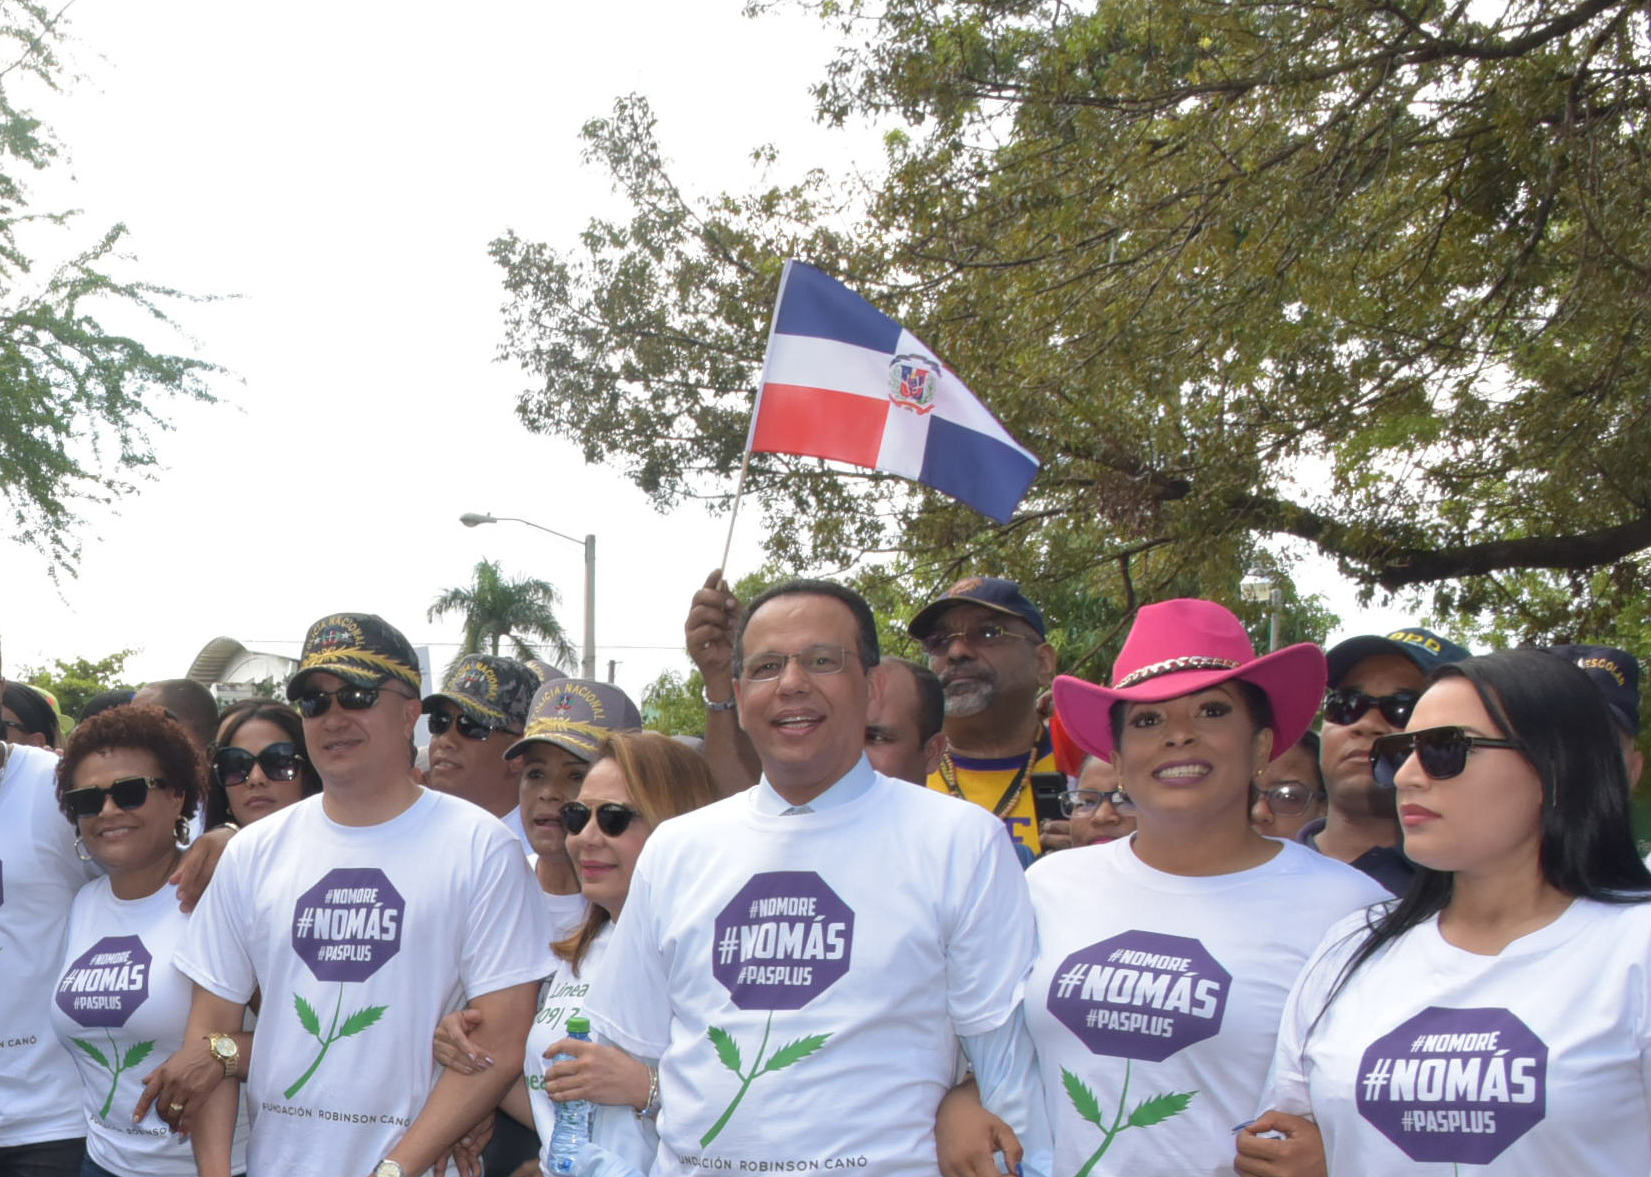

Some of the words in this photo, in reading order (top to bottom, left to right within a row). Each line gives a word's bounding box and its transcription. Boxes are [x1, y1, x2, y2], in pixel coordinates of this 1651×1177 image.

[564, 683, 606, 721] NACIONAL
[324, 888, 379, 904] #NOMORE
[749, 897, 817, 918] #NOMORE
[297, 902, 398, 940] #NOMÁS
[718, 914, 846, 965] #NOMÁS
[317, 945, 372, 961] #PASPLUS
[1108, 948, 1192, 973] #NOMORE
[59, 960, 145, 992] #NOMÁS
[737, 966, 813, 986] #PASPLUS
[74, 996, 122, 1010] #PASPLUS
[1057, 963, 1221, 1020] #NOMÁS
[1085, 1008, 1174, 1038] #PASPLUS
[8, 1035, 38, 1047] CANÓ
[1410, 1031, 1500, 1053] #NOMORE
[1362, 1049, 1537, 1103] #NOMÁS
[318, 1110, 377, 1124] ROBINSON
[1401, 1110, 1497, 1134] #PASPLUS
[677, 1155, 732, 1170] UNDCIÓN
[739, 1159, 819, 1172] ROBINSON
[824, 1155, 867, 1169] CANÓ
